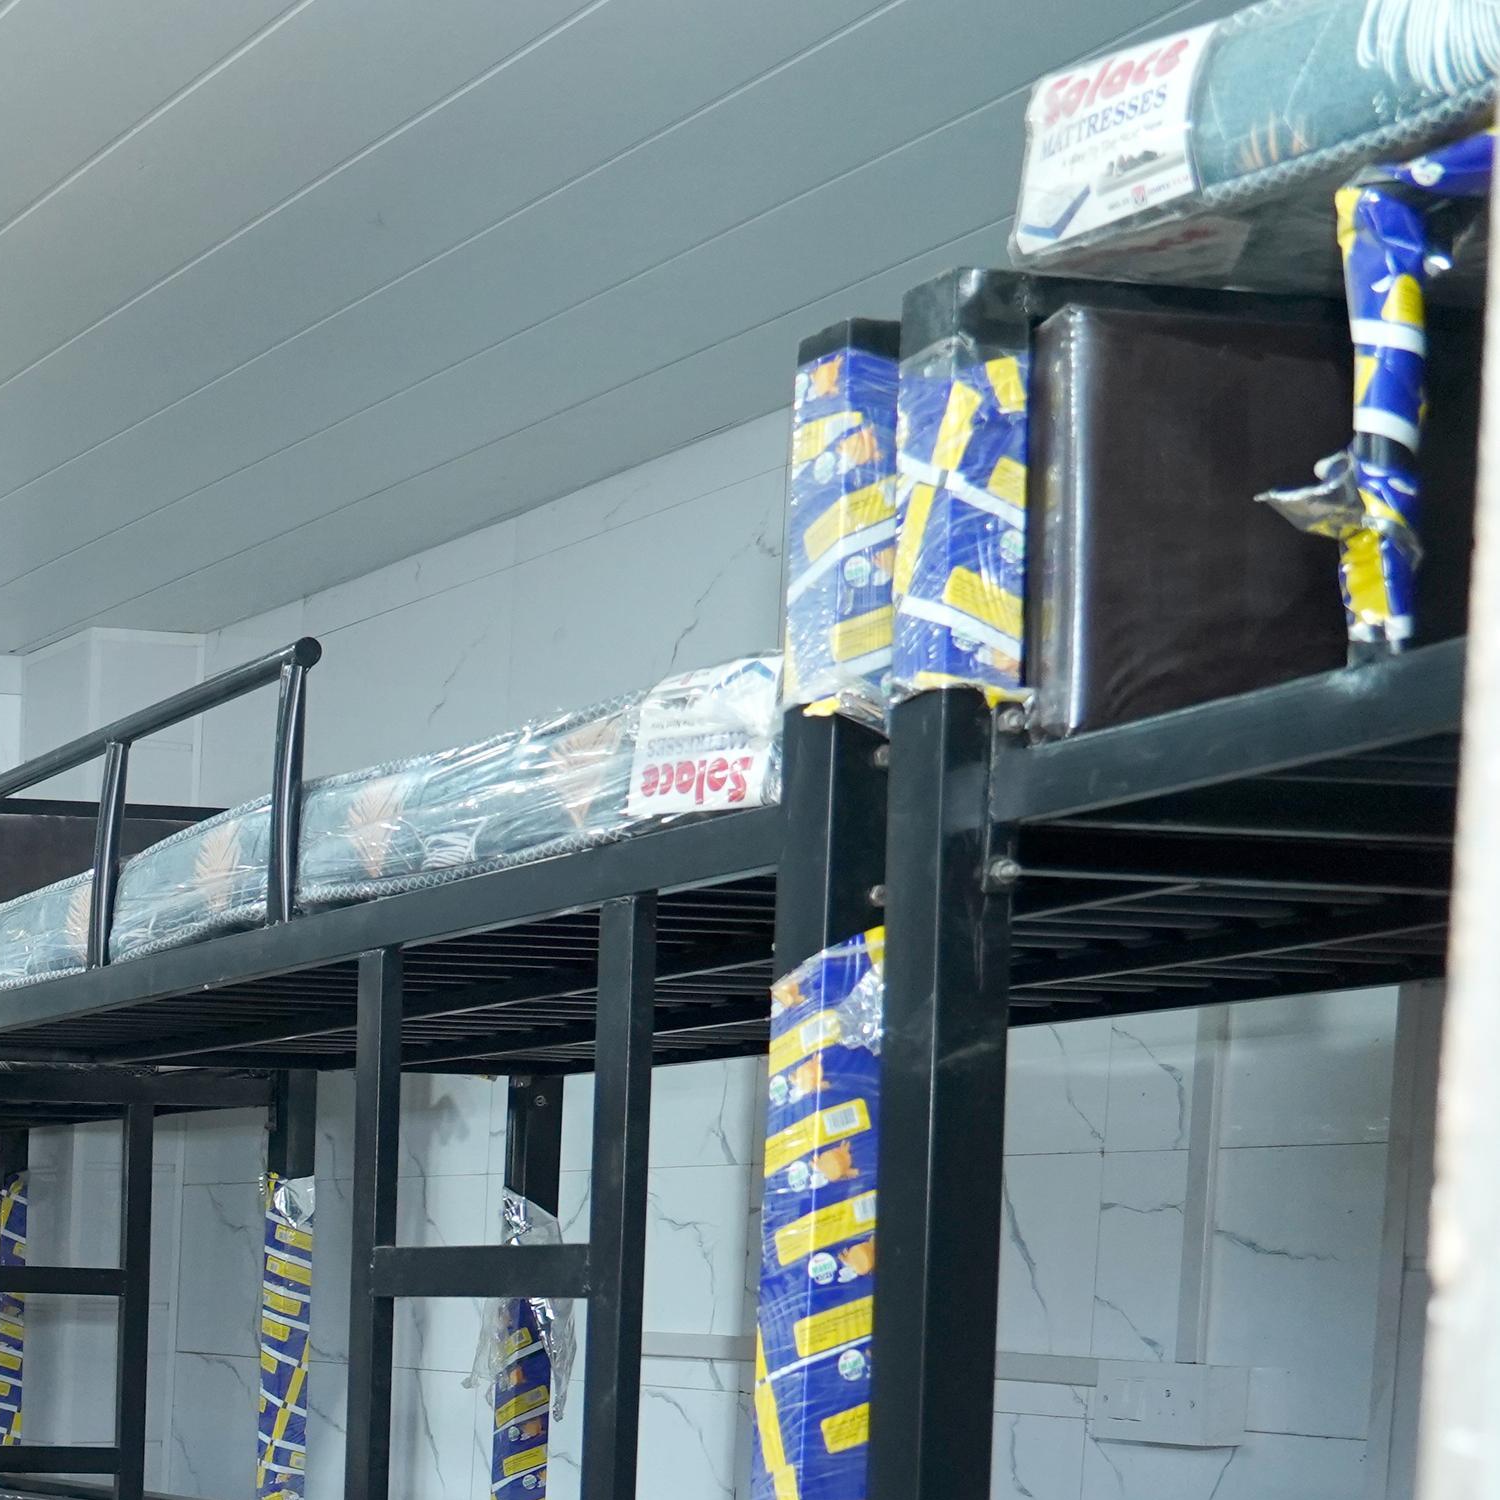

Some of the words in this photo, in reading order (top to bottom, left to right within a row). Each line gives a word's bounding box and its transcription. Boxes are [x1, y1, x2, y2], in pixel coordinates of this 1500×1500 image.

[1040, 83, 1168, 161] MATTRESSES
[1045, 38, 1190, 128] Solace
[640, 756, 754, 805] Solace
